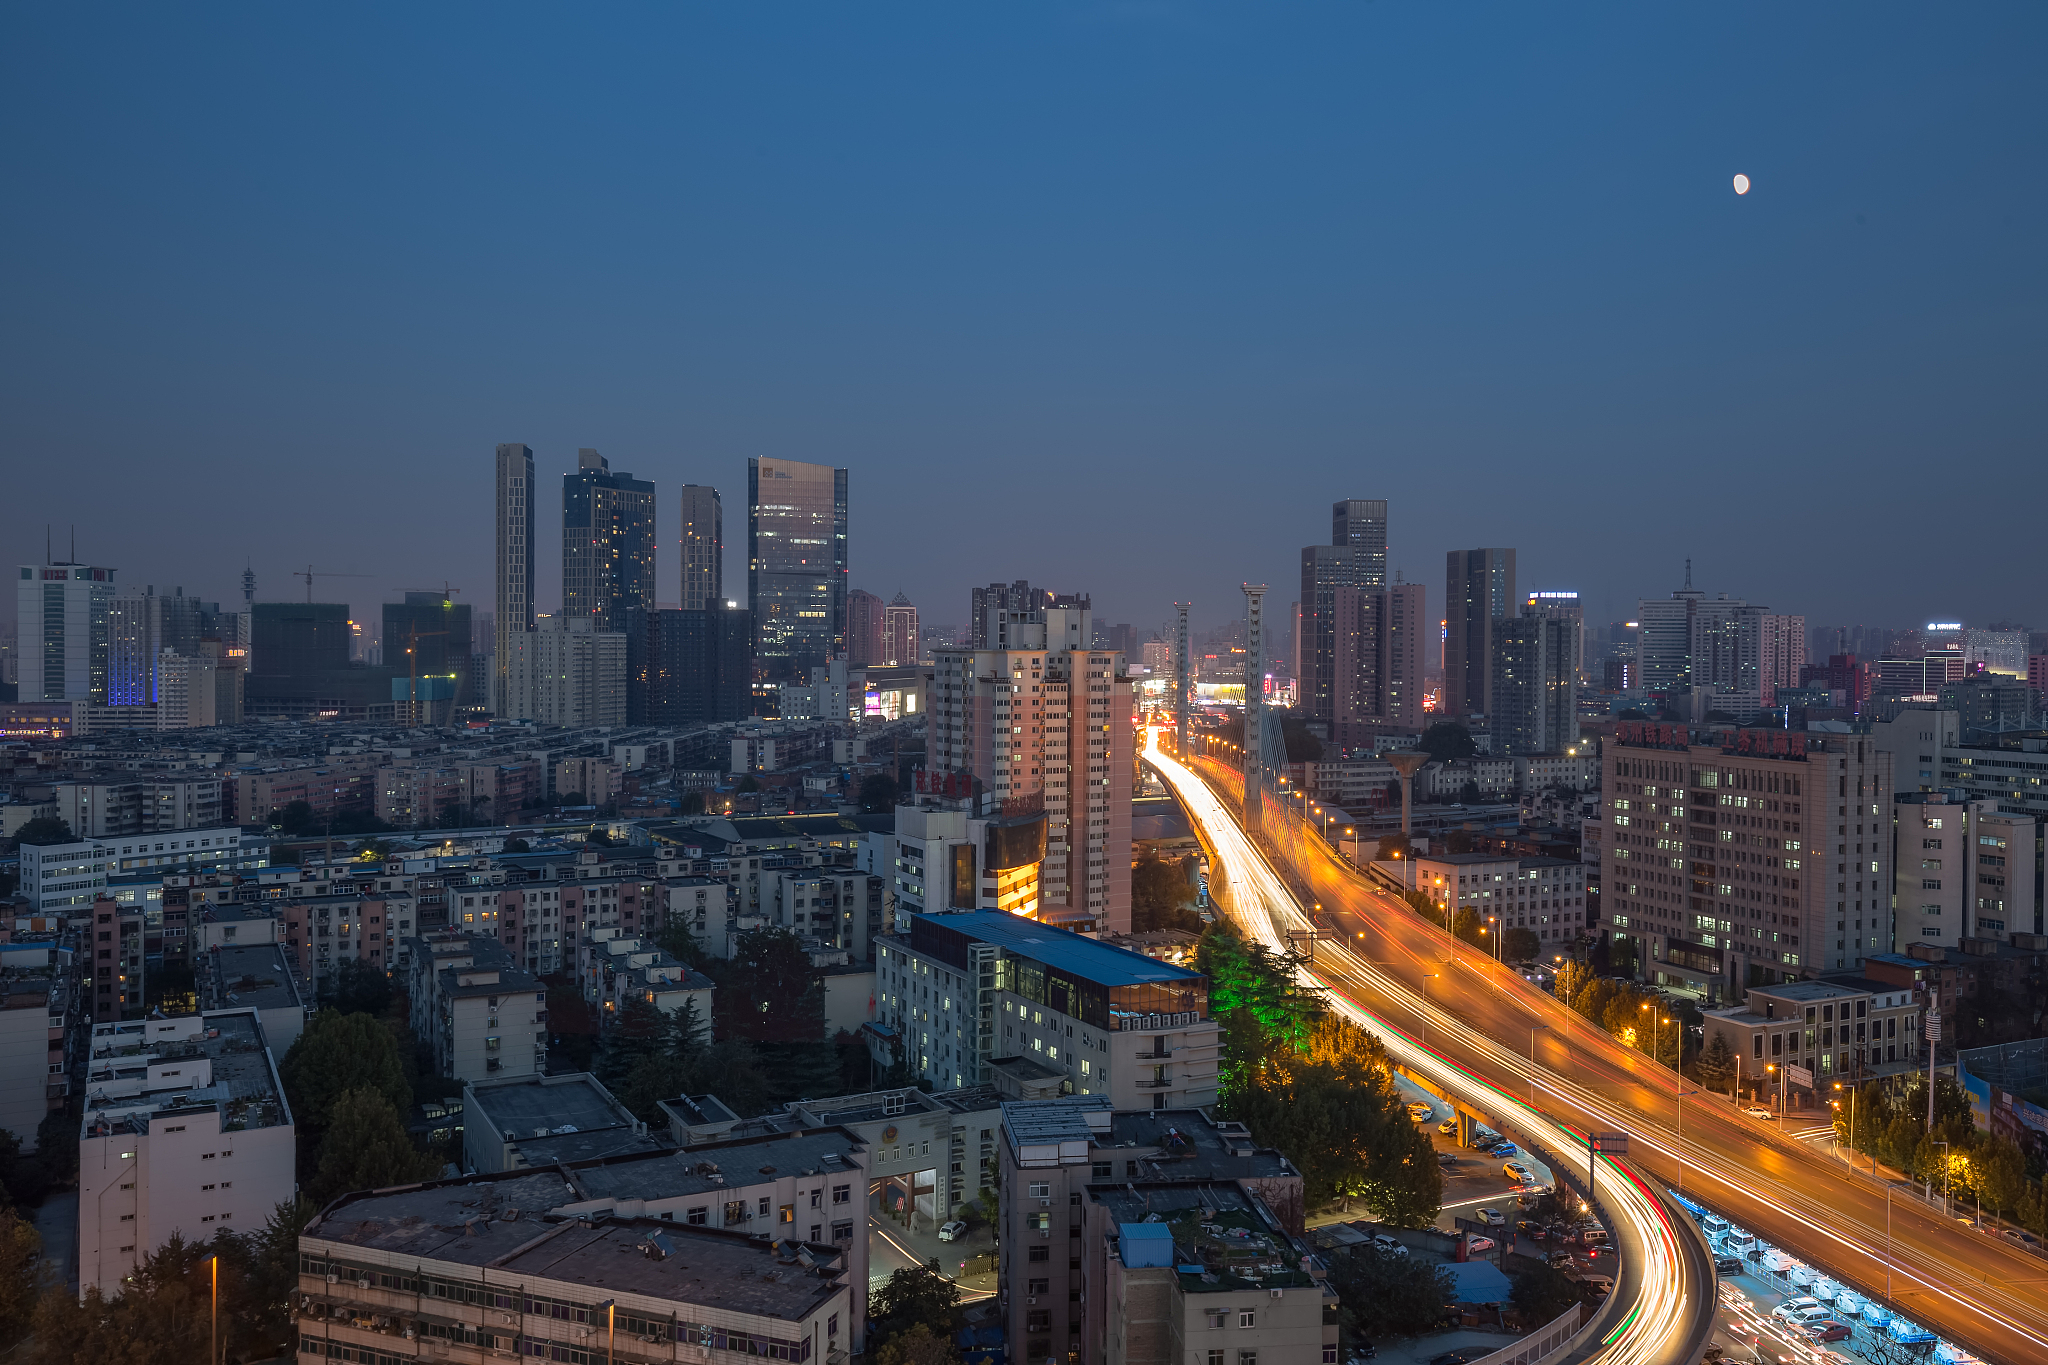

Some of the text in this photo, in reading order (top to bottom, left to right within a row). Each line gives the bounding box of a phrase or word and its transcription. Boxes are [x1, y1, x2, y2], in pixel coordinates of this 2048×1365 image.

[1616, 722, 1806, 756] 郑州铁路局 工务机械段
